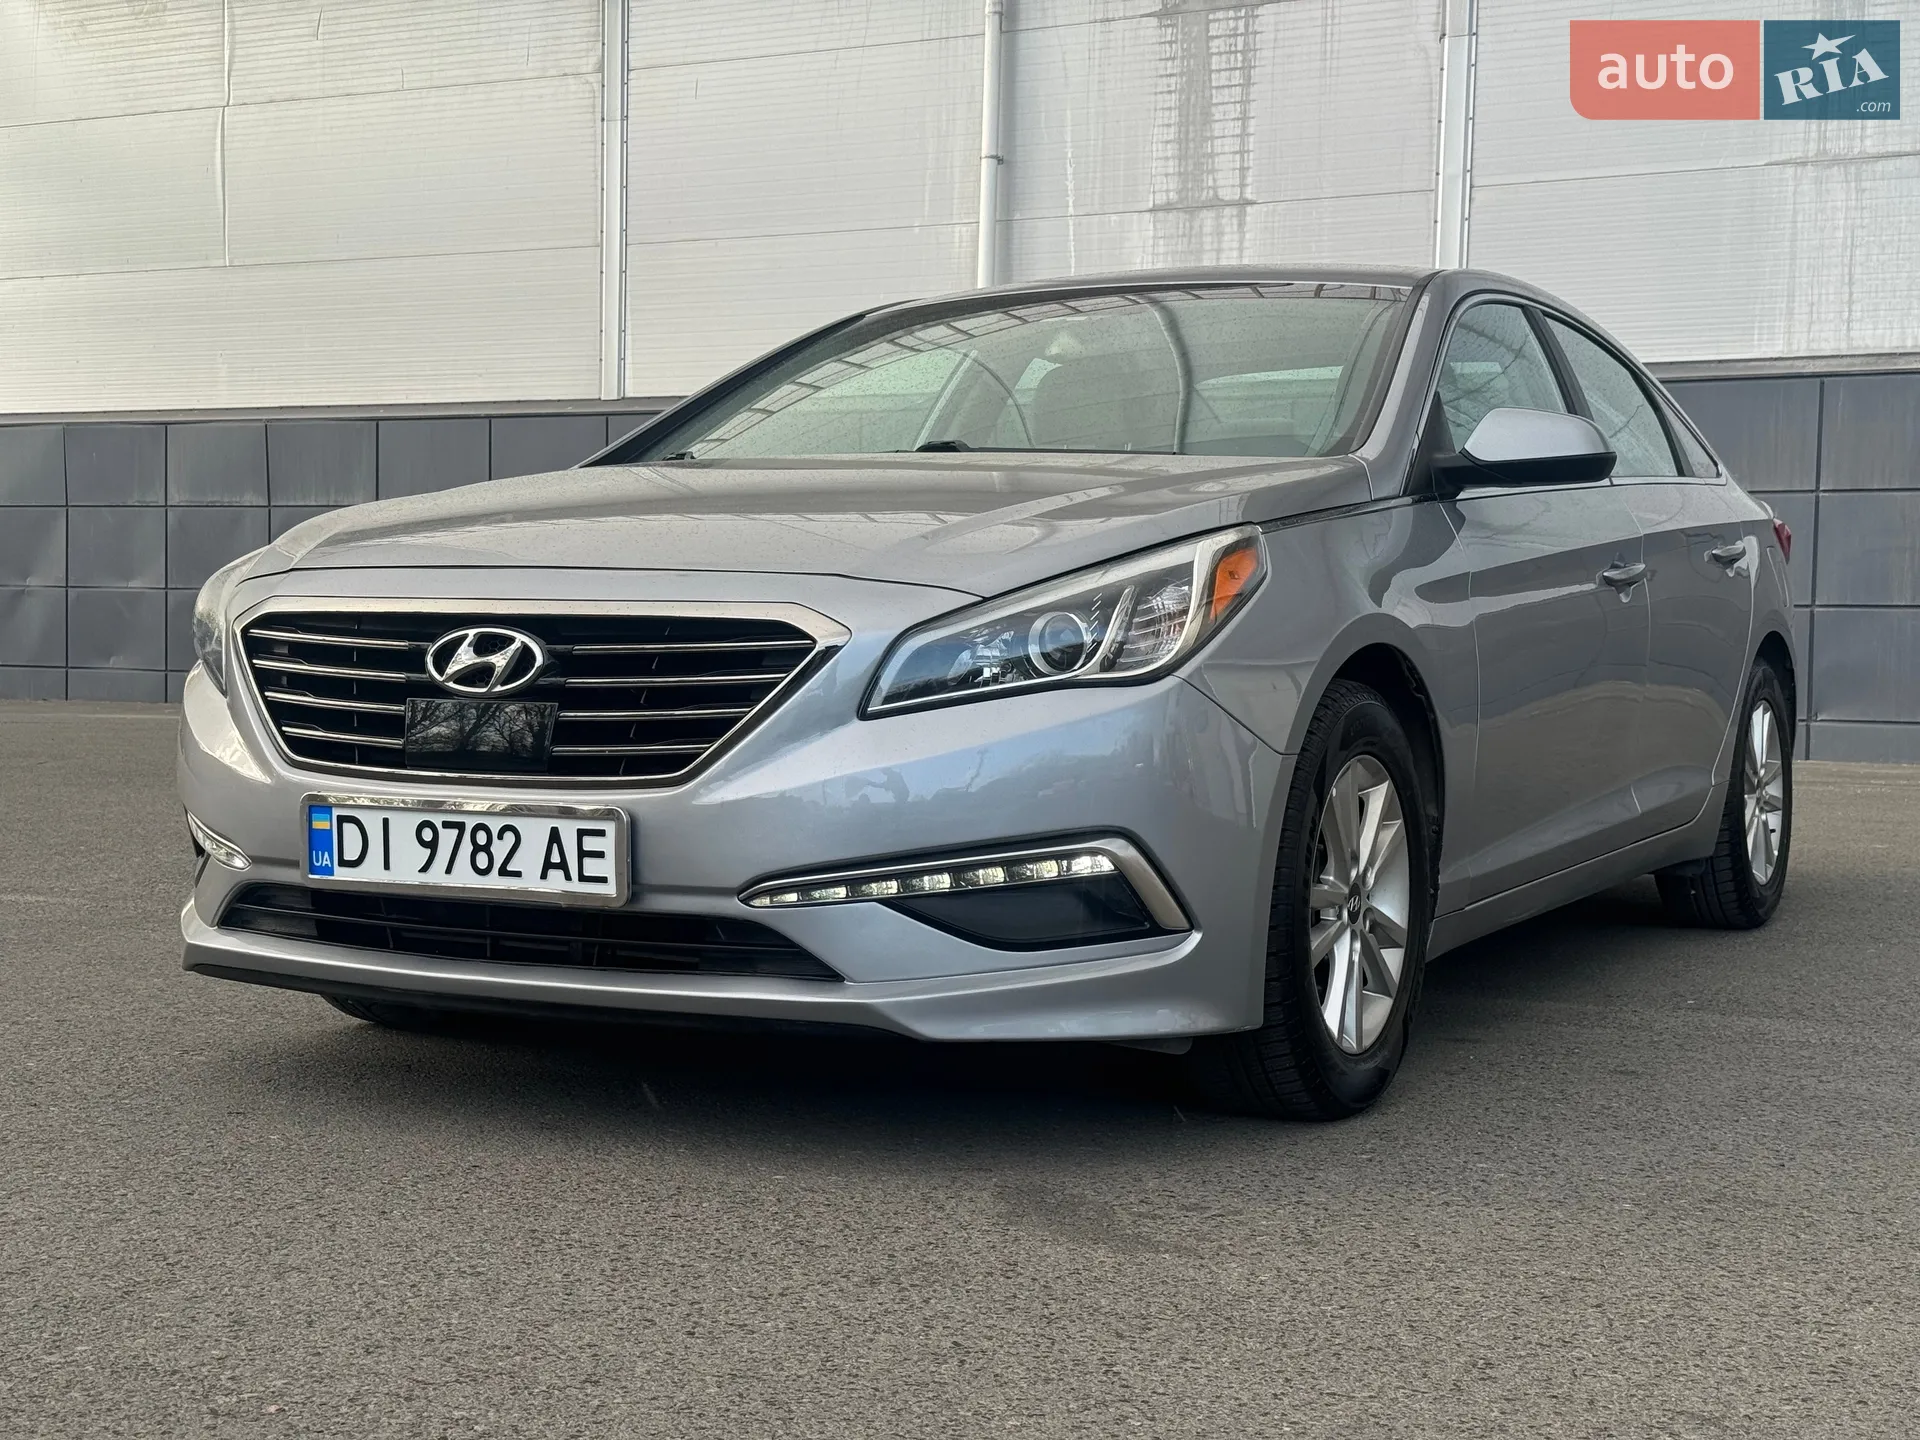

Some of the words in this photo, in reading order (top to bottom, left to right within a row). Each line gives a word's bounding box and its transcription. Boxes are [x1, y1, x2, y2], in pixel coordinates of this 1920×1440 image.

[312, 850, 332, 868] UA
[336, 814, 391, 871] DI
[415, 819, 523, 878] 9782
[540, 826, 609, 884] AE
